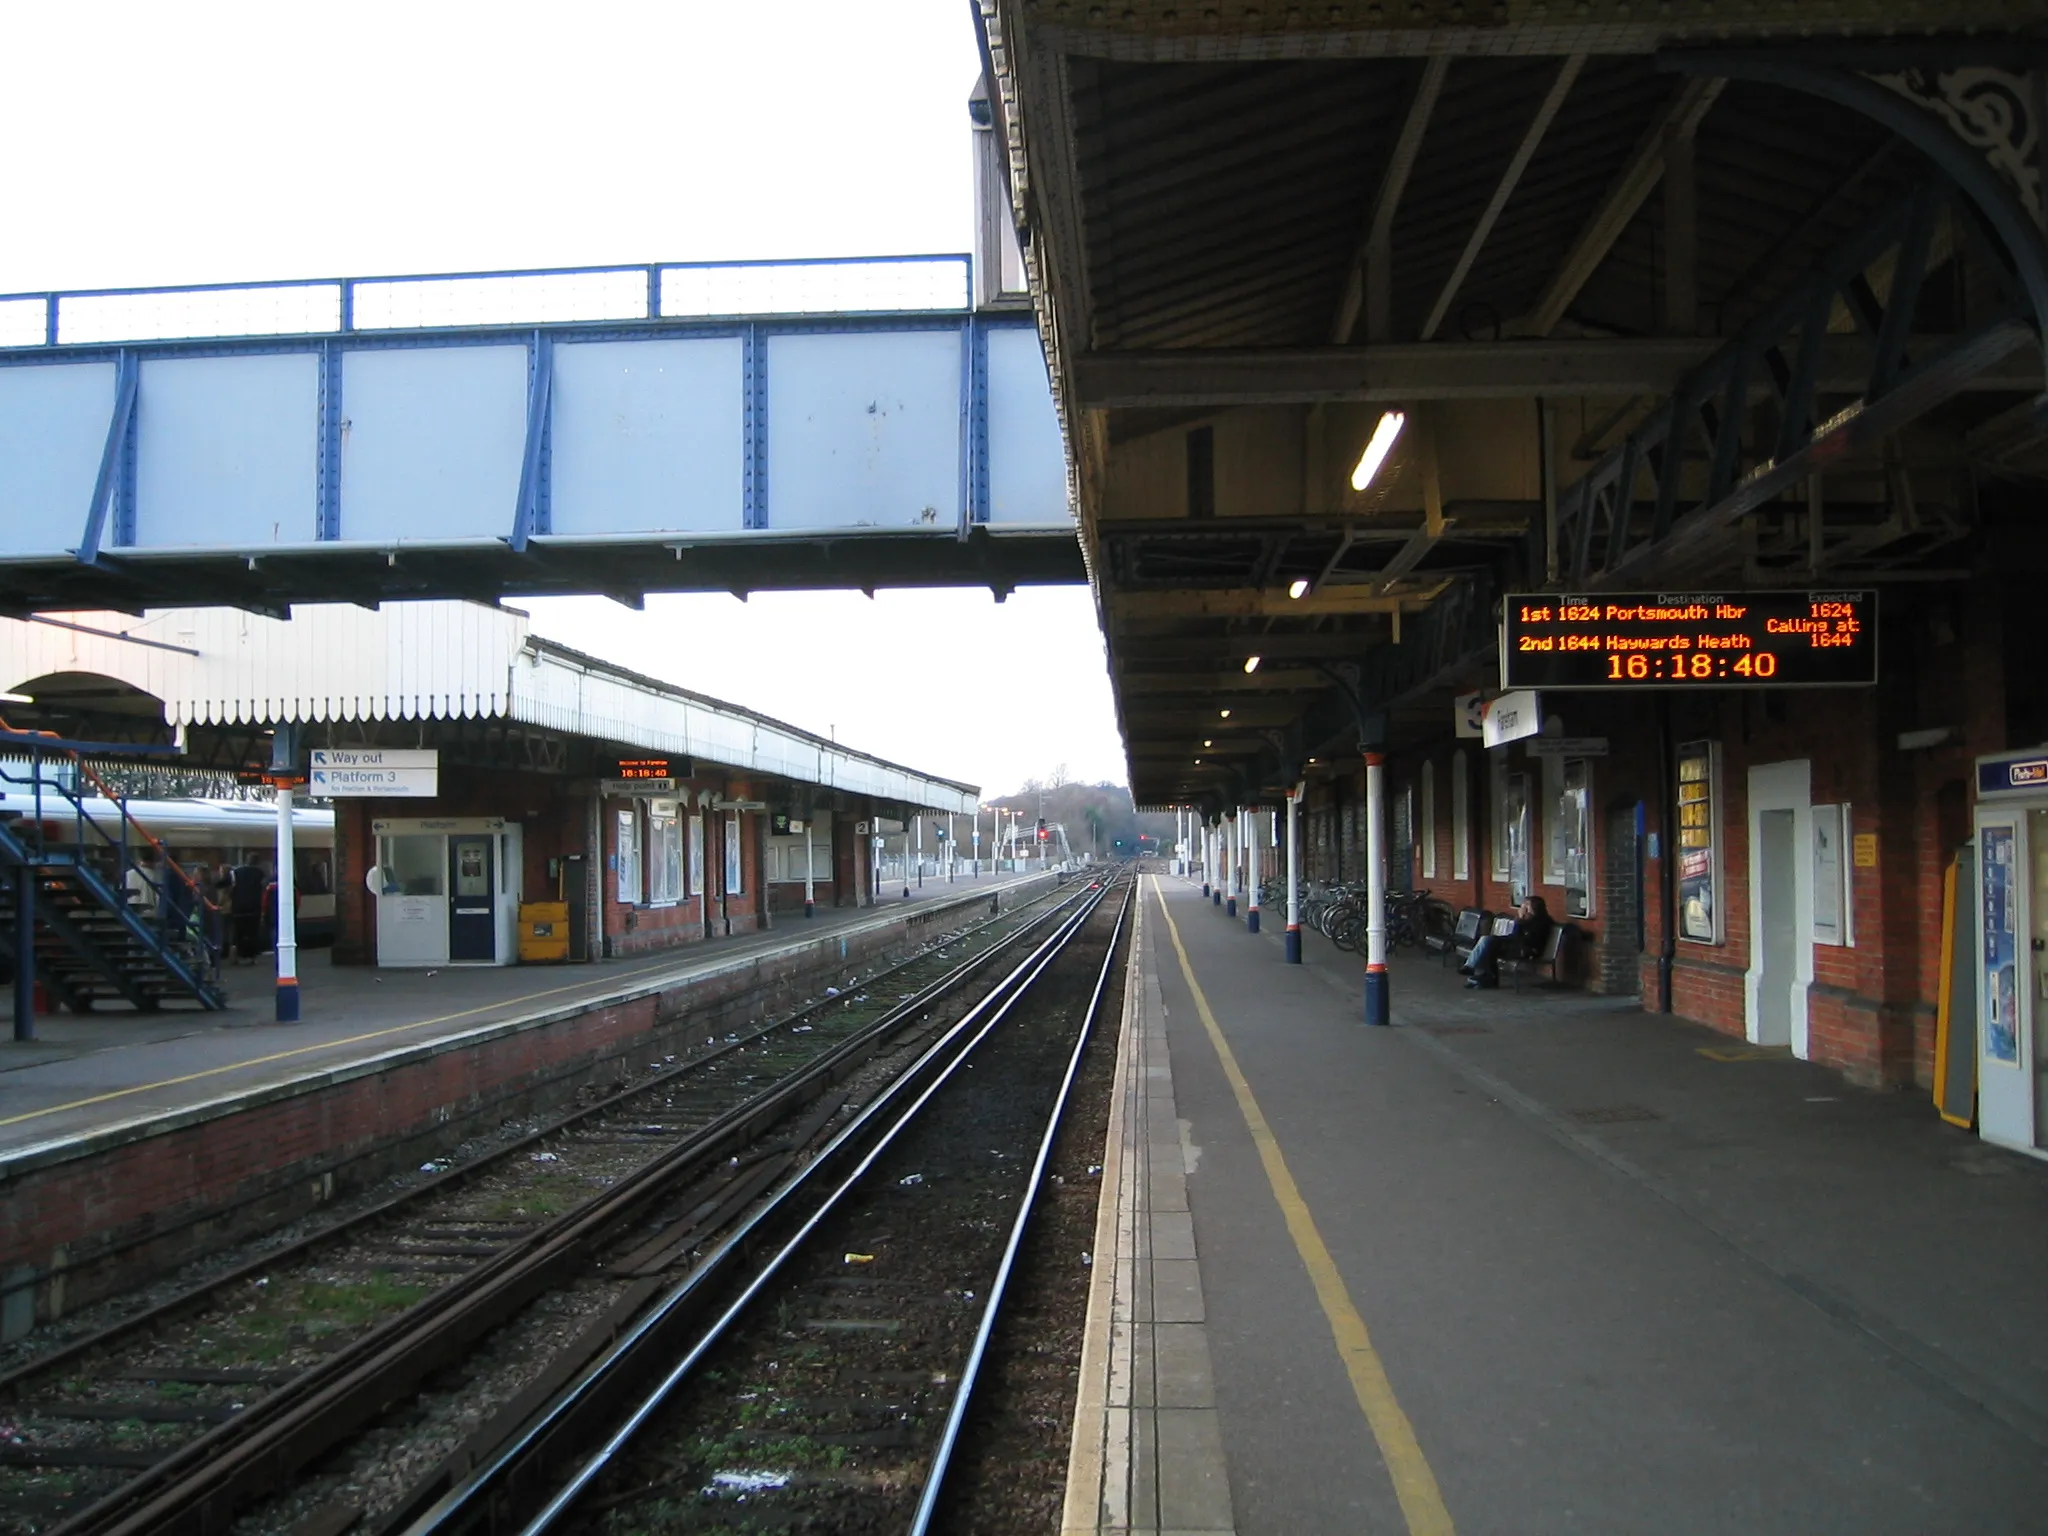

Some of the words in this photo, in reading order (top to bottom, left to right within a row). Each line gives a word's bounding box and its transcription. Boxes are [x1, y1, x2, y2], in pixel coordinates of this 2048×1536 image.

[1559, 595, 1588, 606] Time
[1657, 593, 1724, 605] Destination
[1808, 591, 1863, 604] Expected
[1520, 606, 1551, 622] 1st
[1557, 606, 1600, 621] 1624
[1606, 605, 1708, 621] Portsmouth
[1716, 604, 1746, 619] Hbr
[1810, 603, 1852, 618] 1624
[1767, 618, 1827, 634] Calling
[1519, 636, 1552, 651] 2nd
[1557, 636, 1600, 651] 1644
[1606, 635, 1690, 652] Haywards
[1698, 634, 1751, 650] Heath
[1810, 633, 1852, 648] 1644
[1607, 652, 1776, 679] 16:18:40
[331, 752, 358, 765] Way
[362, 752, 383, 763] out
[331, 771, 384, 783] Platform
[387, 771, 396, 782] 3
[621, 769, 667, 778] 16:18:40
[858, 822, 866, 832] 2
